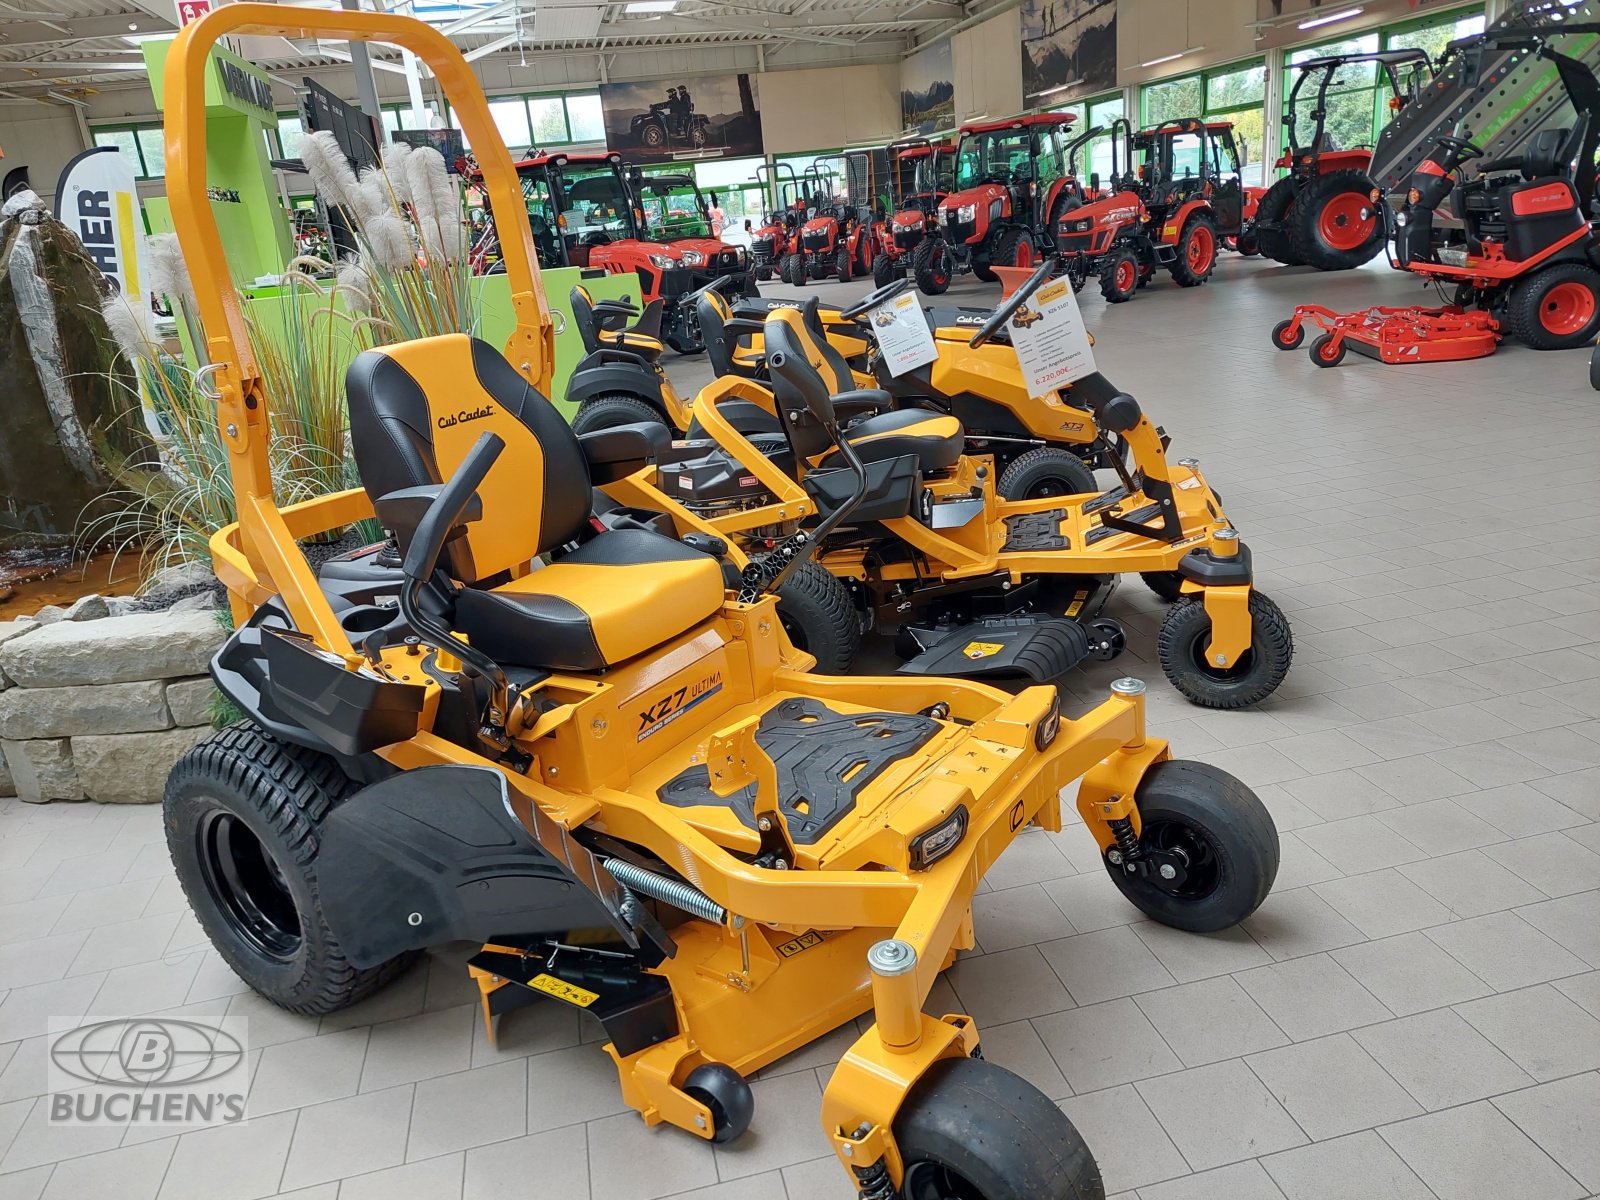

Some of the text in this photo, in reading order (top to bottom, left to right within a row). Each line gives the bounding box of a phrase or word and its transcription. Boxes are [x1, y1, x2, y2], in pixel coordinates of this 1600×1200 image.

[1033, 364, 1049, 375] Unser
[1048, 350, 1082, 369] Angebotspreis
[1035, 366, 1069, 386] 6.220,00€
[438, 405, 494, 429] Cub Cadet
[1060, 421, 1084, 430] XT3
[638, 670, 722, 733] XZ7 ULTIMA
[638, 708, 685, 742] ENDURO SERIES
